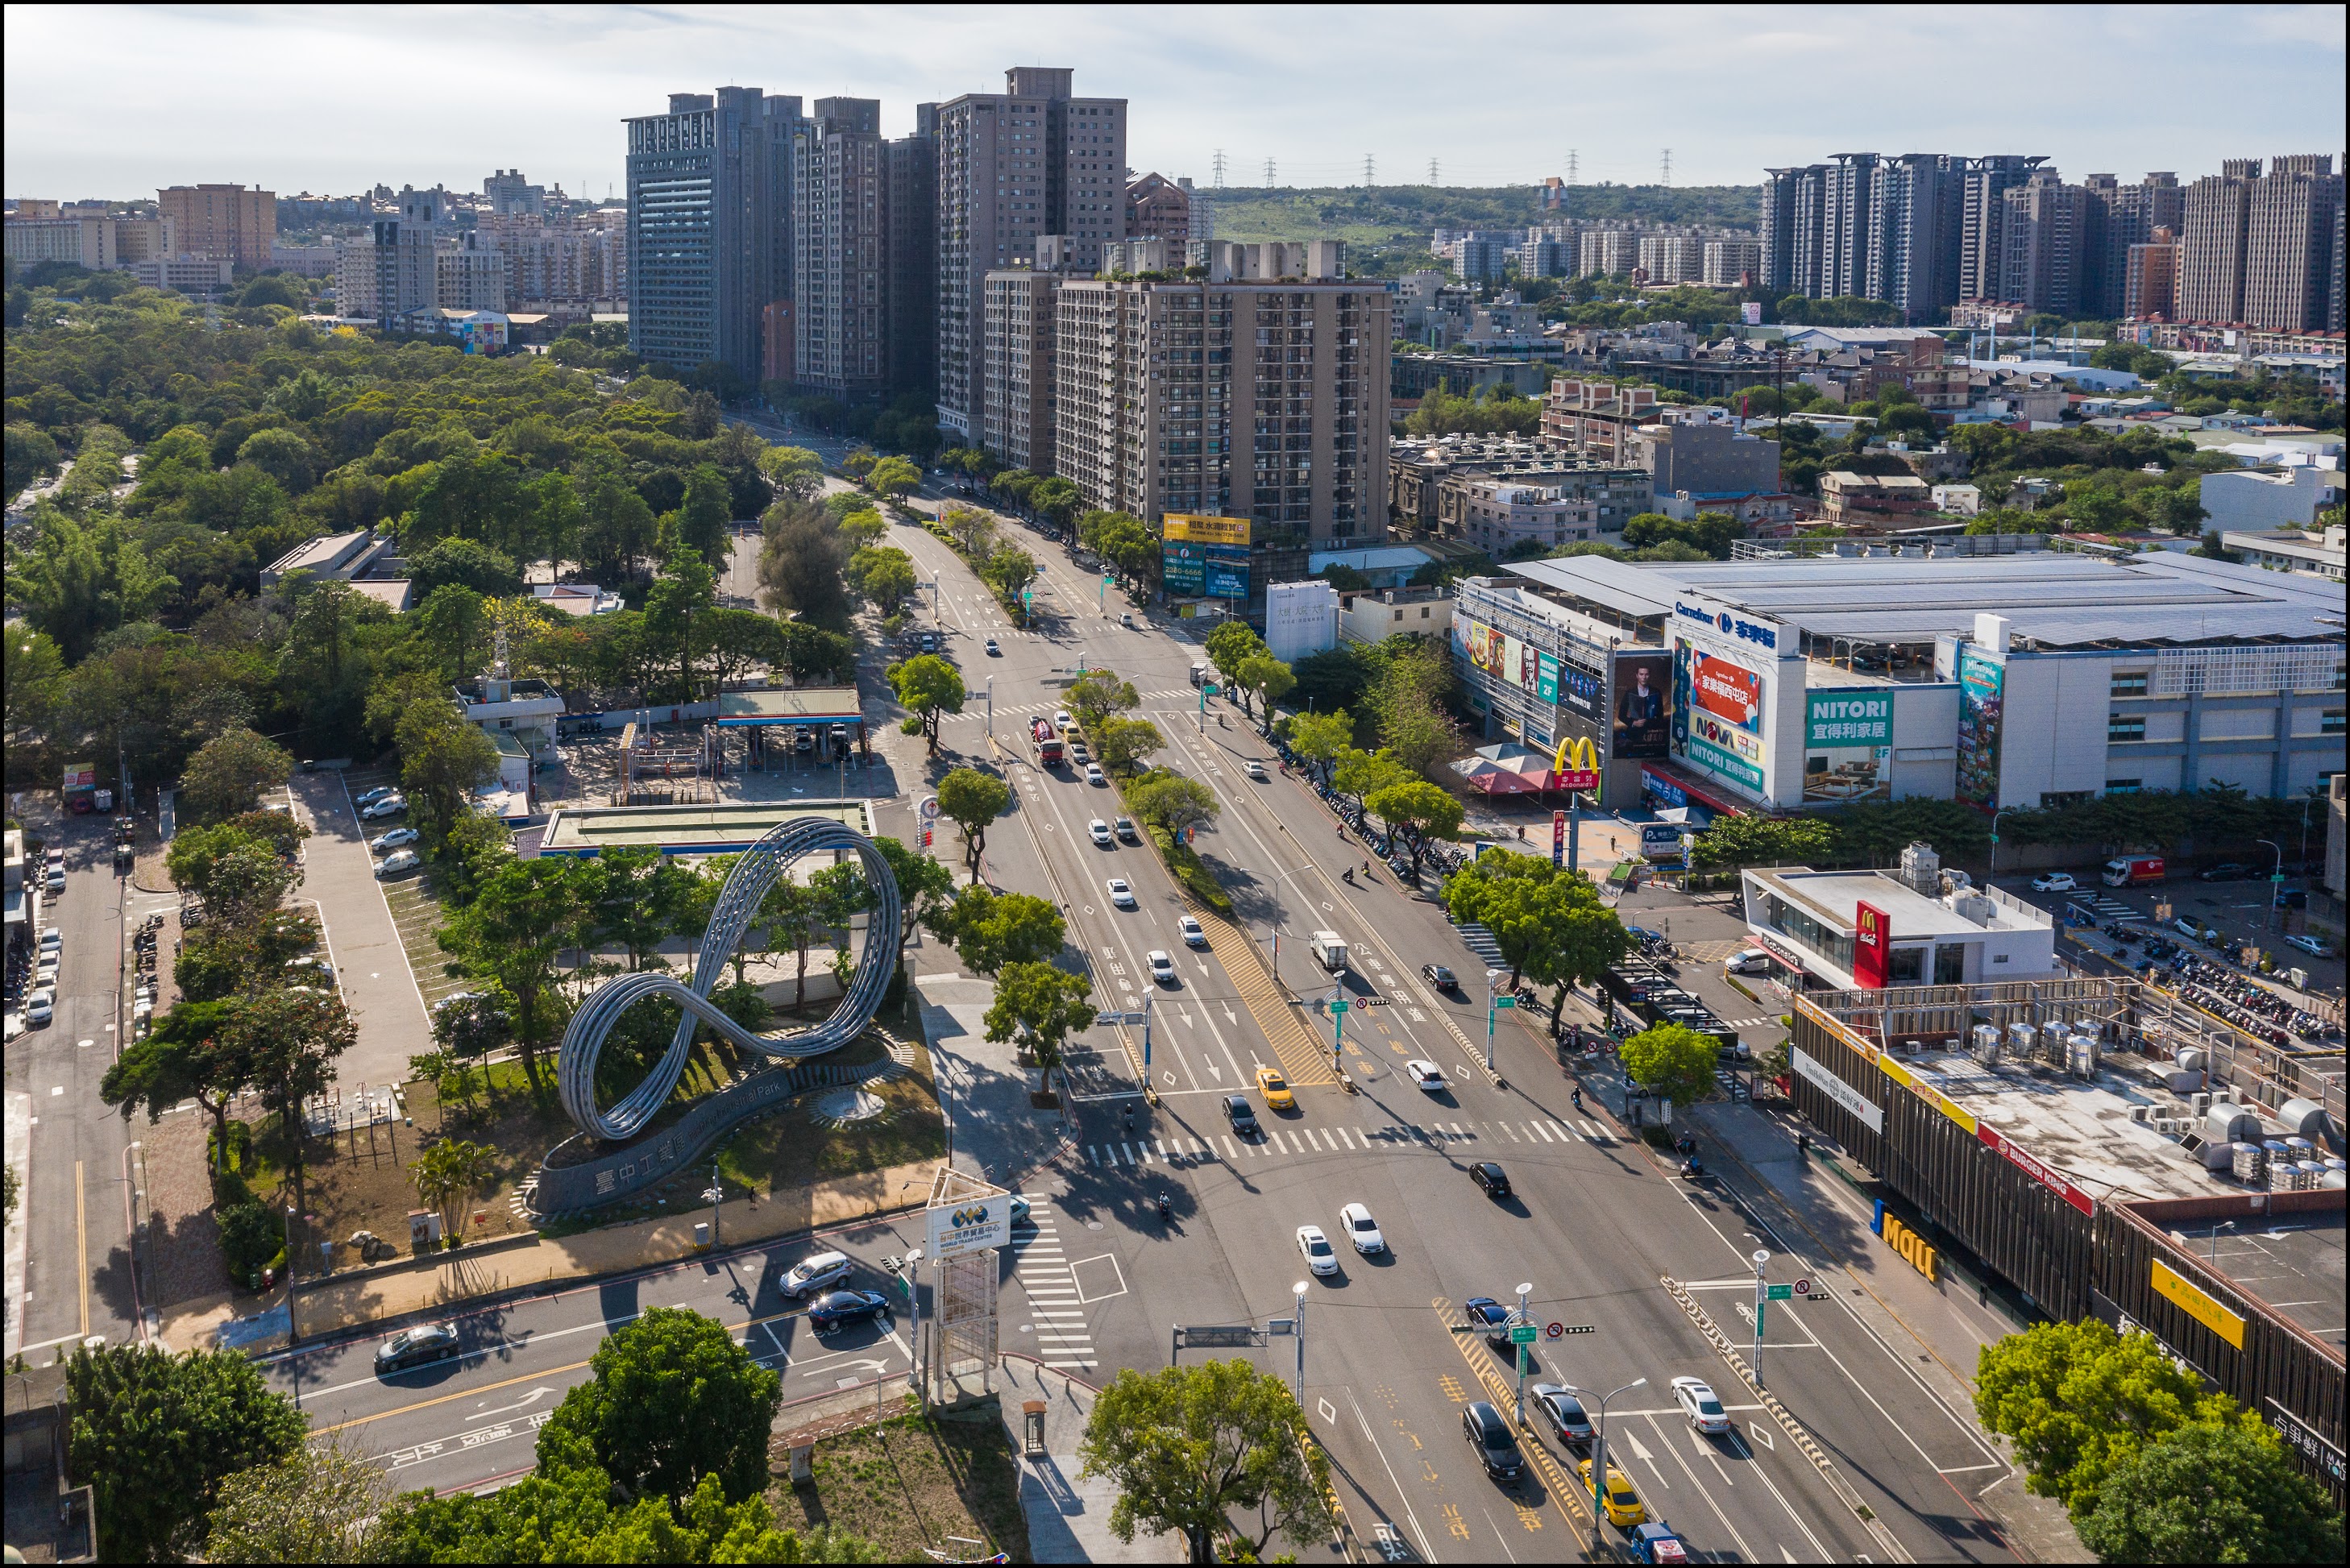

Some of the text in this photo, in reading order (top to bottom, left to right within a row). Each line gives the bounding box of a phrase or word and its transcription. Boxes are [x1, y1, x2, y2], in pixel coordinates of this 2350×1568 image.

[1165, 566, 1202, 576] 2380-6666
[1675, 601, 1714, 625] Carrefour
[1735, 620, 1776, 649] 家樂福
[1539, 657, 1558, 672] NITORI
[1543, 684, 1552, 696] 2F
[1702, 674, 1748, 706] 家樂福西屯店
[1813, 700, 1887, 719] NITORI
[1696, 716, 1734, 749] NOVA
[1812, 721, 1886, 740] 宜得利家居
[1874, 748, 1890, 758] 2F
[1691, 741, 1724, 769] NITORI
[1725, 758, 1760, 786] 宜得利家居
[1762, 936, 1799, 966] McDonald's
[1354, 942, 1428, 1023] 公車專用道
[757, 1081, 780, 1101] Park
[595, 1132, 686, 1196] 臺中工業區
[2009, 1147, 2068, 1195] BURGER KING
[940, 1225, 1000, 1243] 台中世界貿易中心
[958, 1237, 974, 1245] TRADE
[974, 1234, 992, 1242] CENTER
[940, 1244, 965, 1254] TAICHUNG
